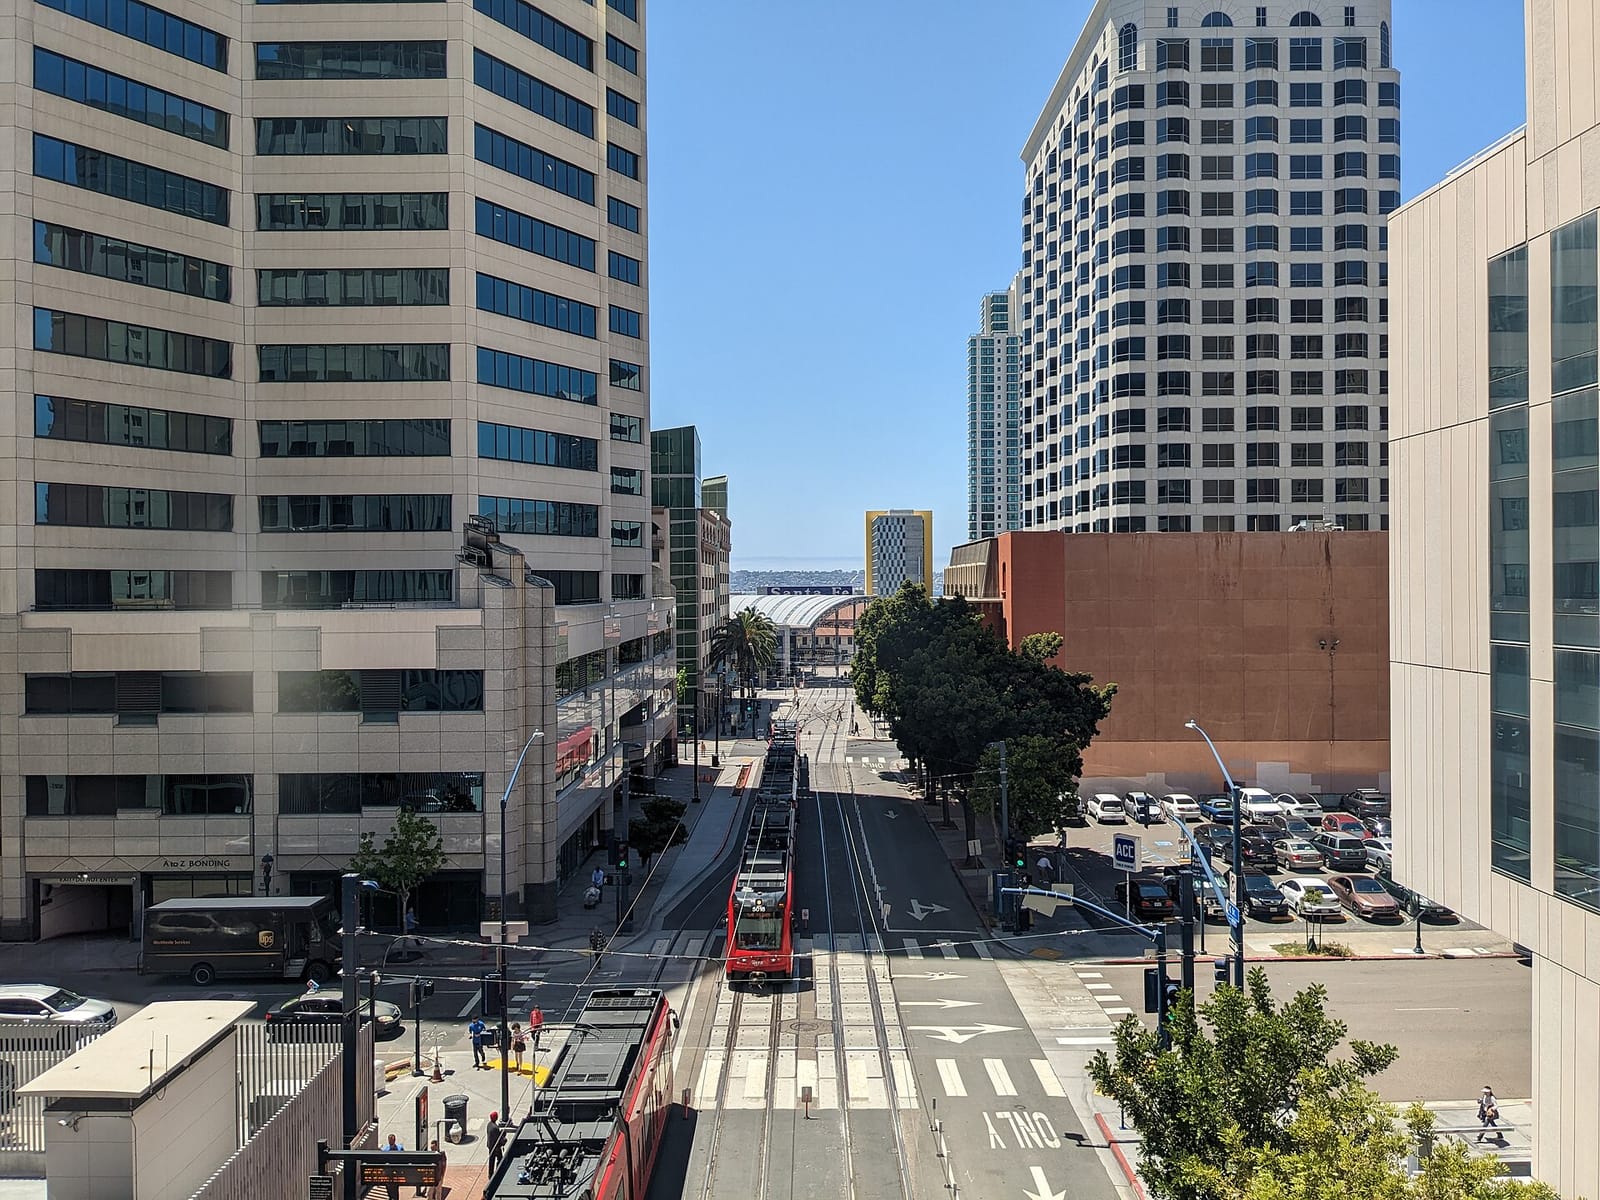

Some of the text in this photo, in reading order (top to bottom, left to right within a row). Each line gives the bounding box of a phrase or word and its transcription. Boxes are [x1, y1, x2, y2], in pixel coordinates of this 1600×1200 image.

[770, 587, 850, 595] Santa Fe
[260, 936, 272, 946] ups
[982, 1111, 1061, 1149] ONLY
